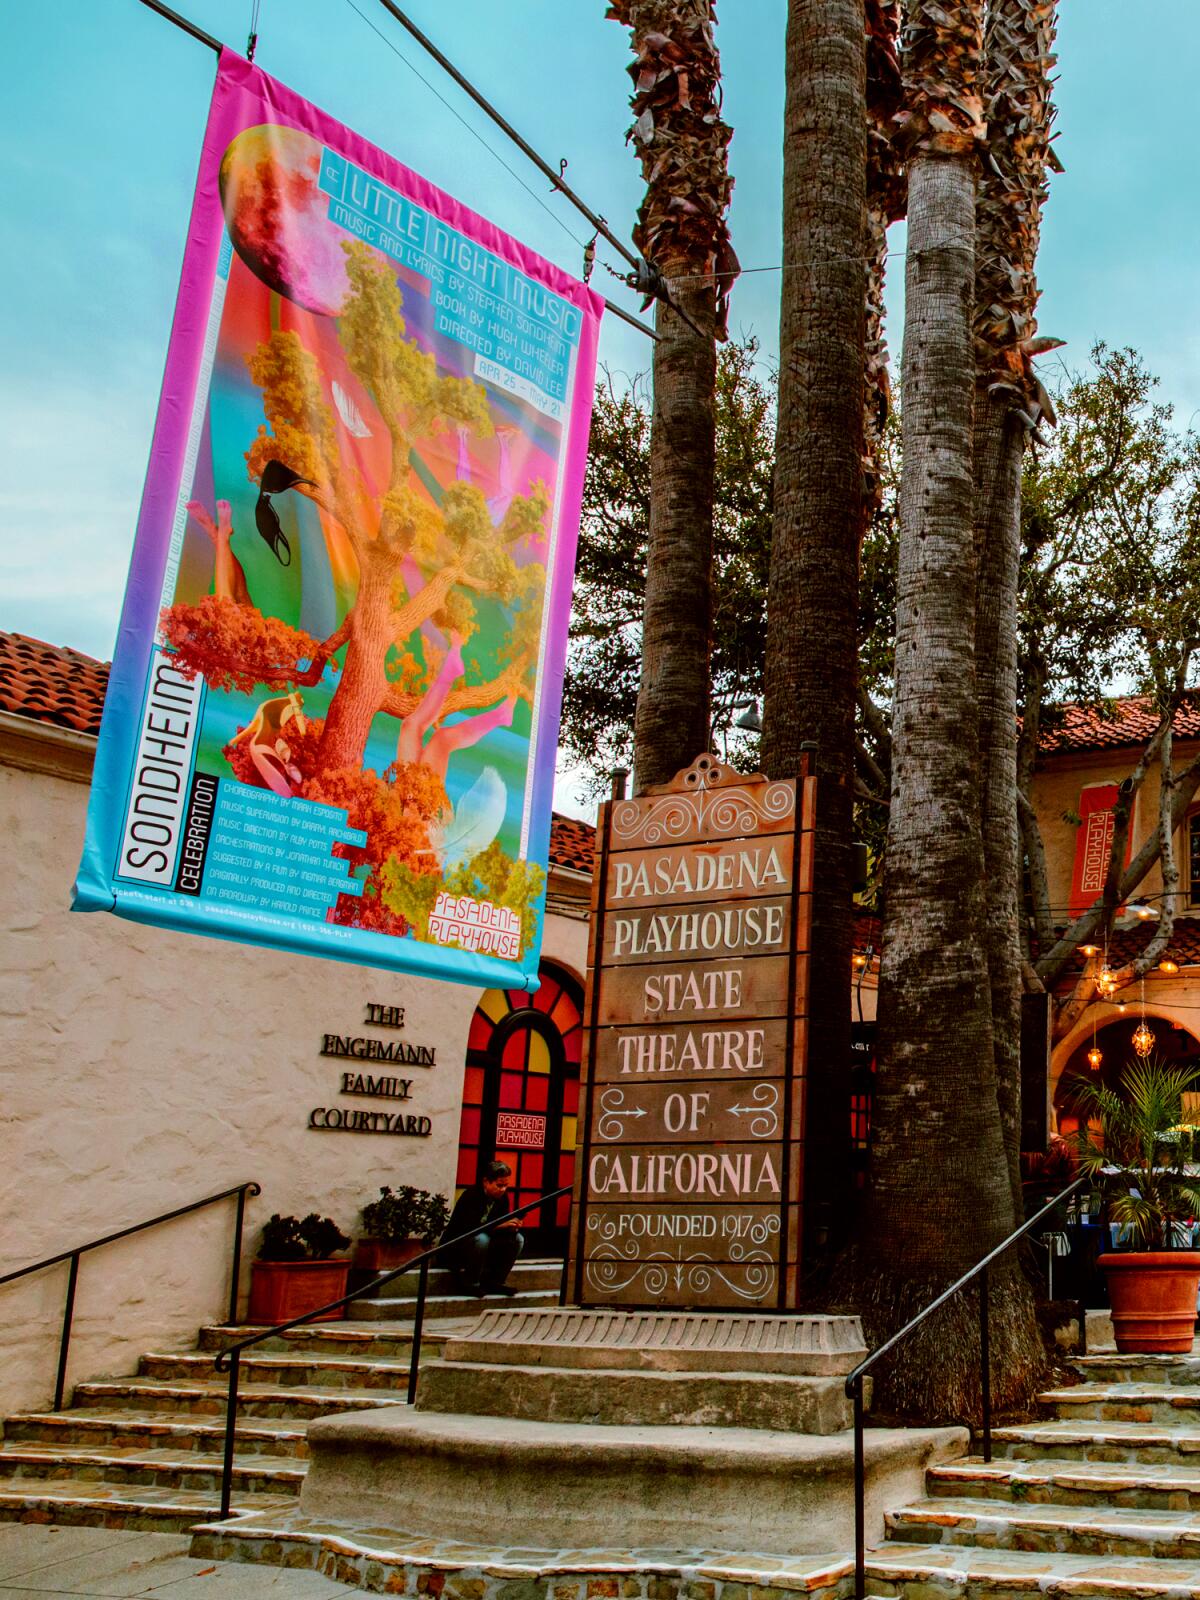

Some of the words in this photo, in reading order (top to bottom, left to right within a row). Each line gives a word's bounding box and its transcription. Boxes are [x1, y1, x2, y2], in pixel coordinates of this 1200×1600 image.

[335, 205, 376, 241] MUSIC
[379, 232, 403, 259] AND
[407, 250, 445, 284] LYRICS
[448, 276, 465, 292] BY
[467, 286, 514, 326] STEPHEN
[351, 174, 422, 242] LITTLE
[434, 227, 501, 289] NIGHT
[513, 275, 577, 337] MUSIC
[435, 290, 467, 318] BOOK
[469, 307, 485, 328] BY
[487, 320, 518, 347] HUGH
[439, 315, 493, 356] DIRECTED
[496, 347, 511, 365] BY
[514, 357, 544, 386] DAVID
[545, 378, 563, 398] LEE
[479, 361, 500, 381] APR
[503, 373, 516, 389] 25
[530, 387, 549, 409] MAY
[126, 663, 195, 873] SONDHEIM
[221, 799, 244, 814] MUSIC
[245, 805, 289, 824] SUPERVISION
[291, 817, 301, 828] BY
[280, 797, 290, 808] BY
[181, 778, 216, 890] CELEBRATION
[218, 817, 241, 831] MUSIC
[243, 822, 277, 840] DIRECTION
[279, 830, 289, 841] BY
[212, 851, 253, 868] SUGGESTED
[253, 859, 264, 870] BY
[288, 867, 299, 878] BY
[275, 847, 285, 858] BY
[286, 849, 321, 866] JONATHAN
[1084, 814, 1105, 889] PLAYHOUSE
[209, 868, 249, 884] ORIGINALLY
[250, 877, 286, 893] PRODUCED
[286, 884, 302, 896] AND
[302, 888, 332, 903] DIRECTED
[611, 847, 788, 899] PASADENA
[206, 886, 218, 896] ON
[260, 896, 270, 908] BY
[434, 894, 519, 930] PASADENA
[429, 920, 518, 957] PLAYHOUSE
[612, 905, 784, 956] PLAYHOUSE
[644, 970, 742, 1013] STATE
[364, 1002, 405, 1028] THE
[319, 1034, 436, 1067] ENGEMANN
[618, 1029, 765, 1074] THEATRE
[339, 1072, 414, 1099] FAMILY
[308, 1107, 432, 1137] COURTYARD
[500, 1115, 544, 1130] PASADENA
[664, 1092, 710, 1133] OF
[499, 1130, 543, 1145] PLAYHOUSE
[589, 1151, 781, 1197] CALIFORNIA
[618, 1213, 717, 1238] FOUNDED
[721, 1214, 753, 1244] 1917
